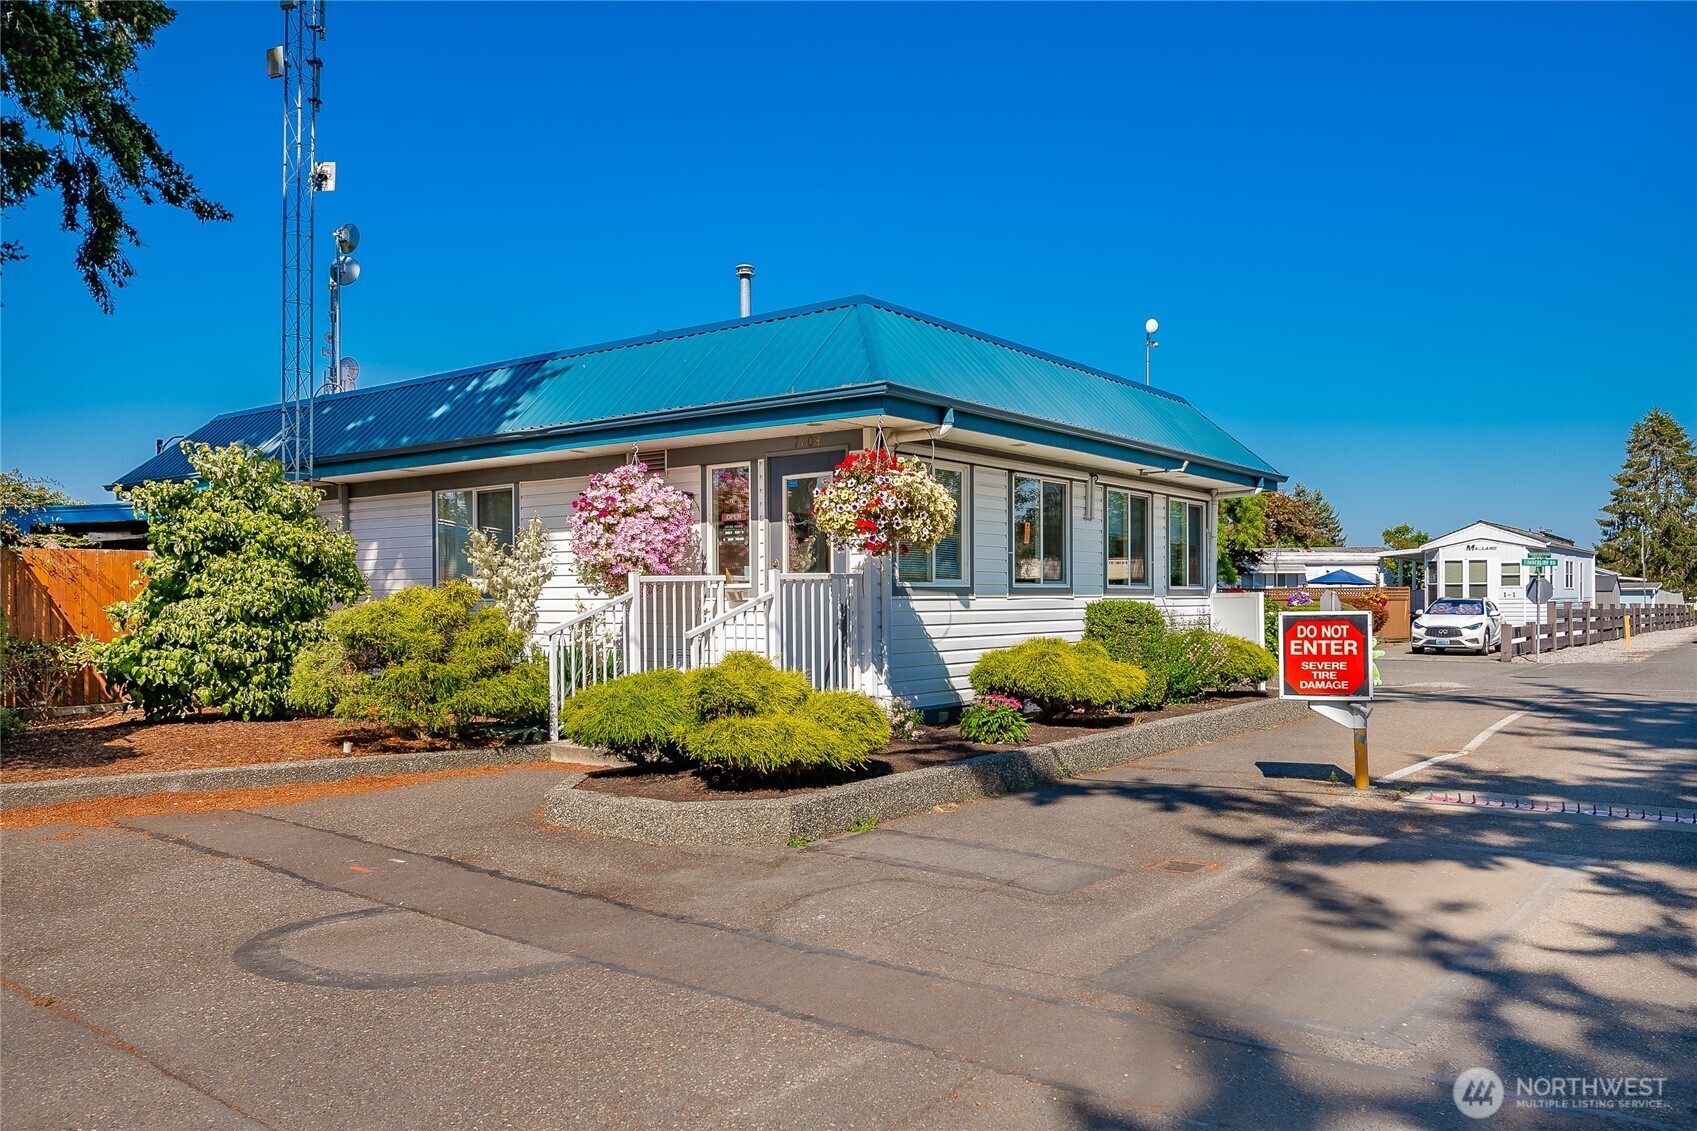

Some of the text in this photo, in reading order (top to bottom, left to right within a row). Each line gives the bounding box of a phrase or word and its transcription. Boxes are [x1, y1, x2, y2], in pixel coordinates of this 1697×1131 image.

[1297, 625, 1349, 638] DO NOT
[1290, 640, 1358, 655] ENTER
[1301, 662, 1347, 670] SEVERE
[1312, 671, 1337, 679] TIRE
[1300, 681, 1349, 689] DAMAGE
